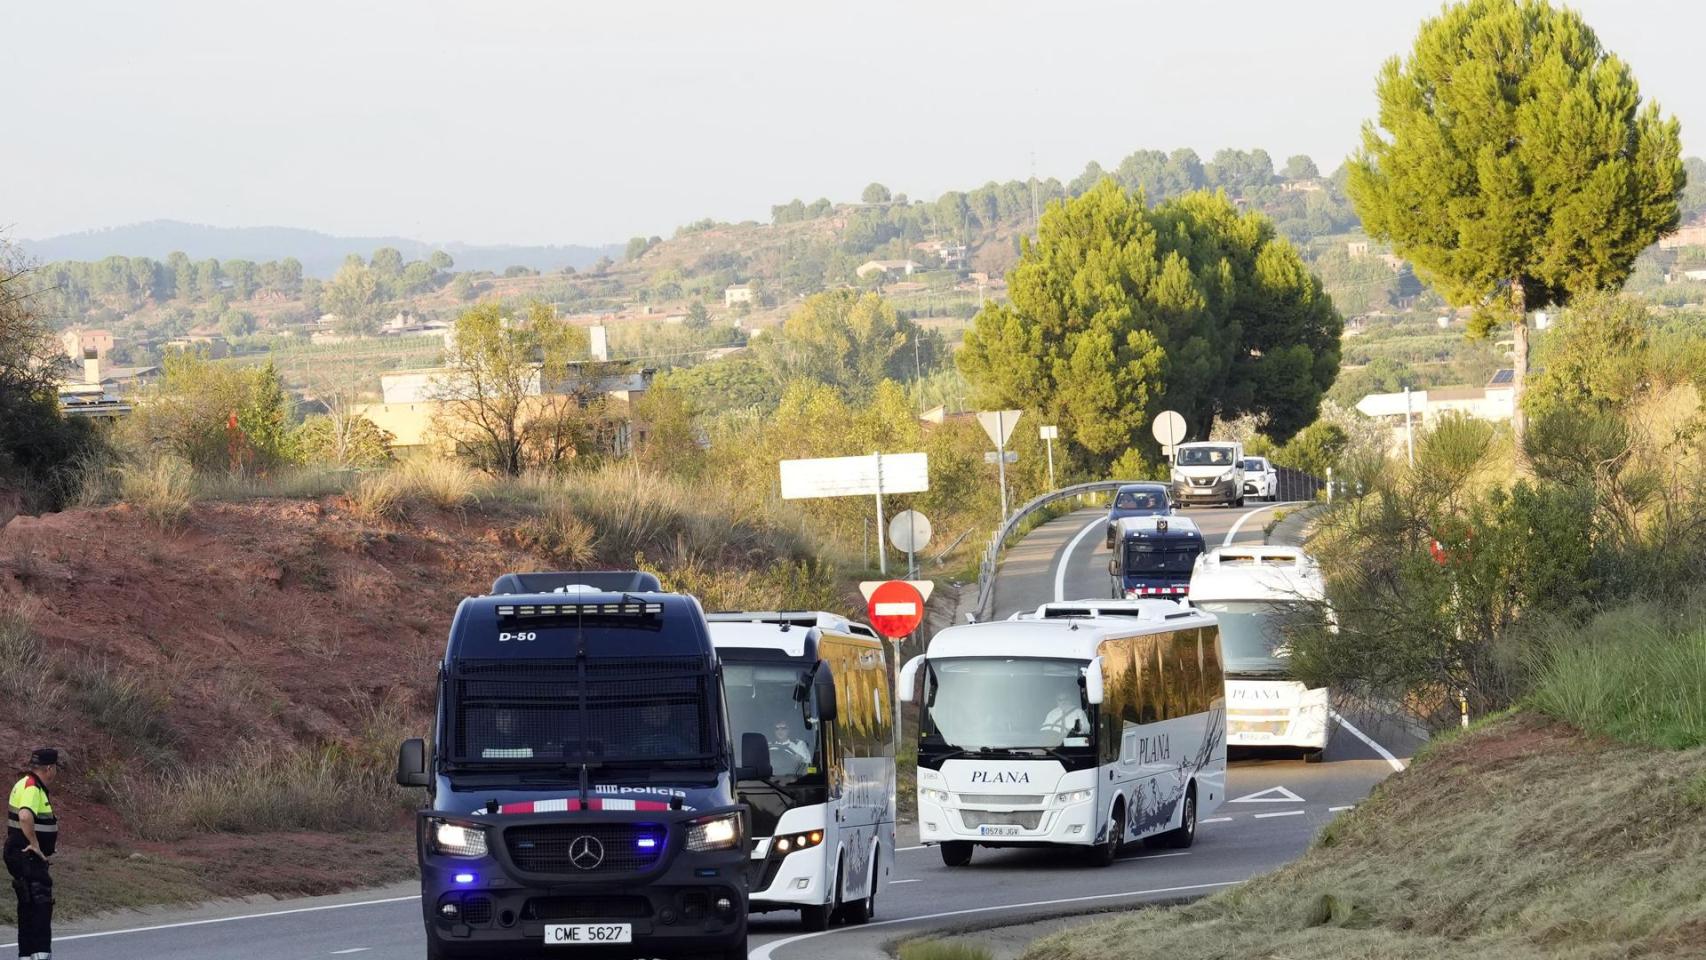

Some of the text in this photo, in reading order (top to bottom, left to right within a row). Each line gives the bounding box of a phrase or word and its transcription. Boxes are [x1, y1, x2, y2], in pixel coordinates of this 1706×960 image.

[499, 632, 537, 641] D-50
[1232, 689, 1280, 699] PLANA
[1139, 733, 1170, 766] PLANA
[971, 771, 1030, 783] PLANA
[620, 786, 687, 798] policia
[555, 922, 623, 941] CME 5627
